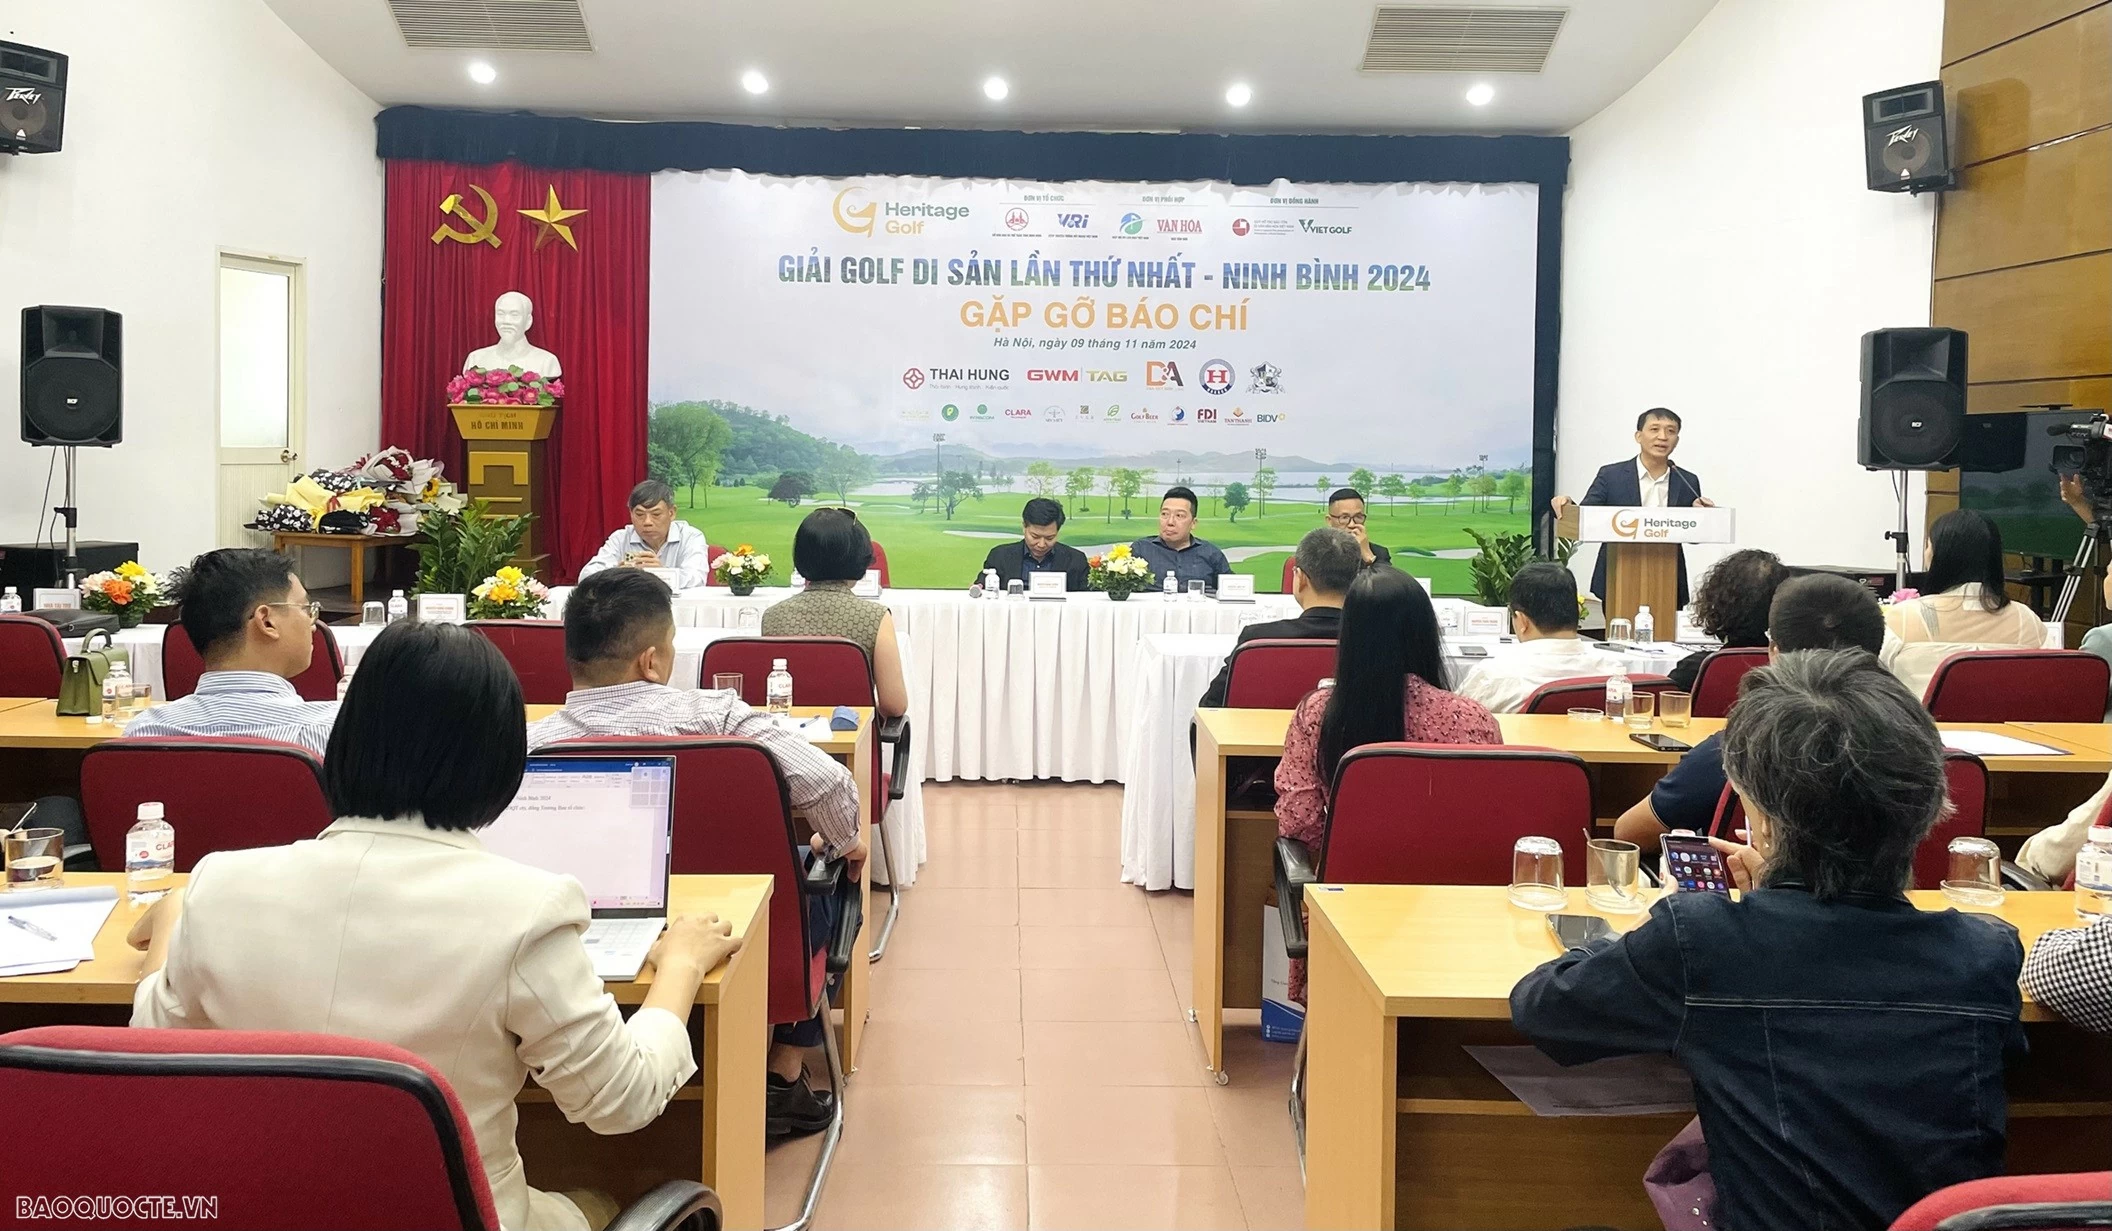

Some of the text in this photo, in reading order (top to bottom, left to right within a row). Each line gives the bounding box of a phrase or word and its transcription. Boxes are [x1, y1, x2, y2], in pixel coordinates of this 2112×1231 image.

[885, 202, 970, 219] Heritage
[885, 220, 925, 236] Golf
[779, 246, 831, 283] GIẢI
[841, 257, 904, 285] GOLF
[913, 258, 938, 286] DI
[948, 250, 1000, 287] SẢN
[1010, 250, 1061, 287] LẦN
[1069, 255, 1121, 288] THỨ
[1127, 252, 1196, 289] NHẤT
[1222, 262, 1287, 290] NINH
[1296, 258, 1359, 291] BÌNH
[1367, 264, 1431, 291] 2024
[960, 294, 1251, 333] GẶP GỠ BÁO CHÍ
[993, 337, 1197, 350] Hà Nội, ngày 09 tháng 11 năm 2024
[930, 368, 1010, 381] THAI HUNG
[1027, 369, 1128, 382] GWM TAG
[1146, 361, 1184, 387] D&A
[1206, 369, 1228, 383] H
[1198, 409, 1217, 419] FDI
[1257, 414, 1278, 422] BIDV
[501, 421, 523, 430] MINH
[1644, 518, 1697, 529] Heritage
[1644, 529, 1669, 538] Golf
